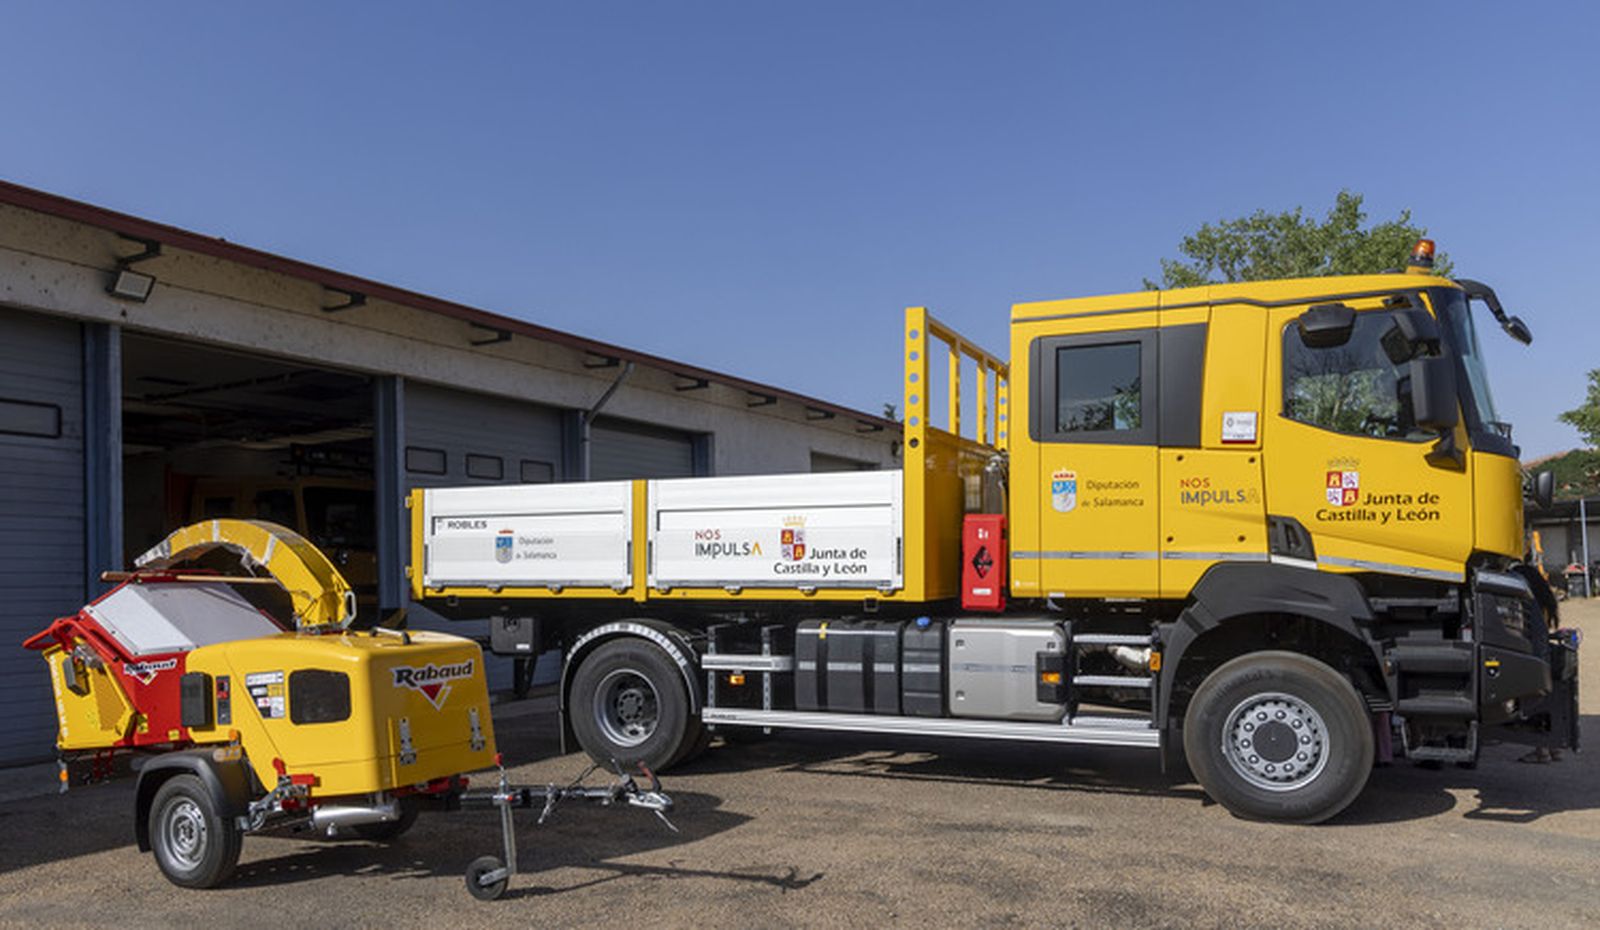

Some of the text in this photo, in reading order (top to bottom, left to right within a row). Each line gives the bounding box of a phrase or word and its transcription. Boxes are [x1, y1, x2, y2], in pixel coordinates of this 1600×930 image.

[1086, 480, 1140, 491] Diputación
[1180, 478, 1211, 488] NOS
[1093, 497, 1144, 508] Salamanca
[1363, 492, 1440, 505] Junta de
[1315, 508, 1440, 525] Castilla y León
[447, 520, 488, 530] ROBLES
[695, 529, 721, 540] NOS
[695, 542, 763, 559] IMPULSA
[809, 548, 867, 560] Junta de
[773, 561, 868, 577] Castilla y León
[393, 660, 474, 689] Rabaud
